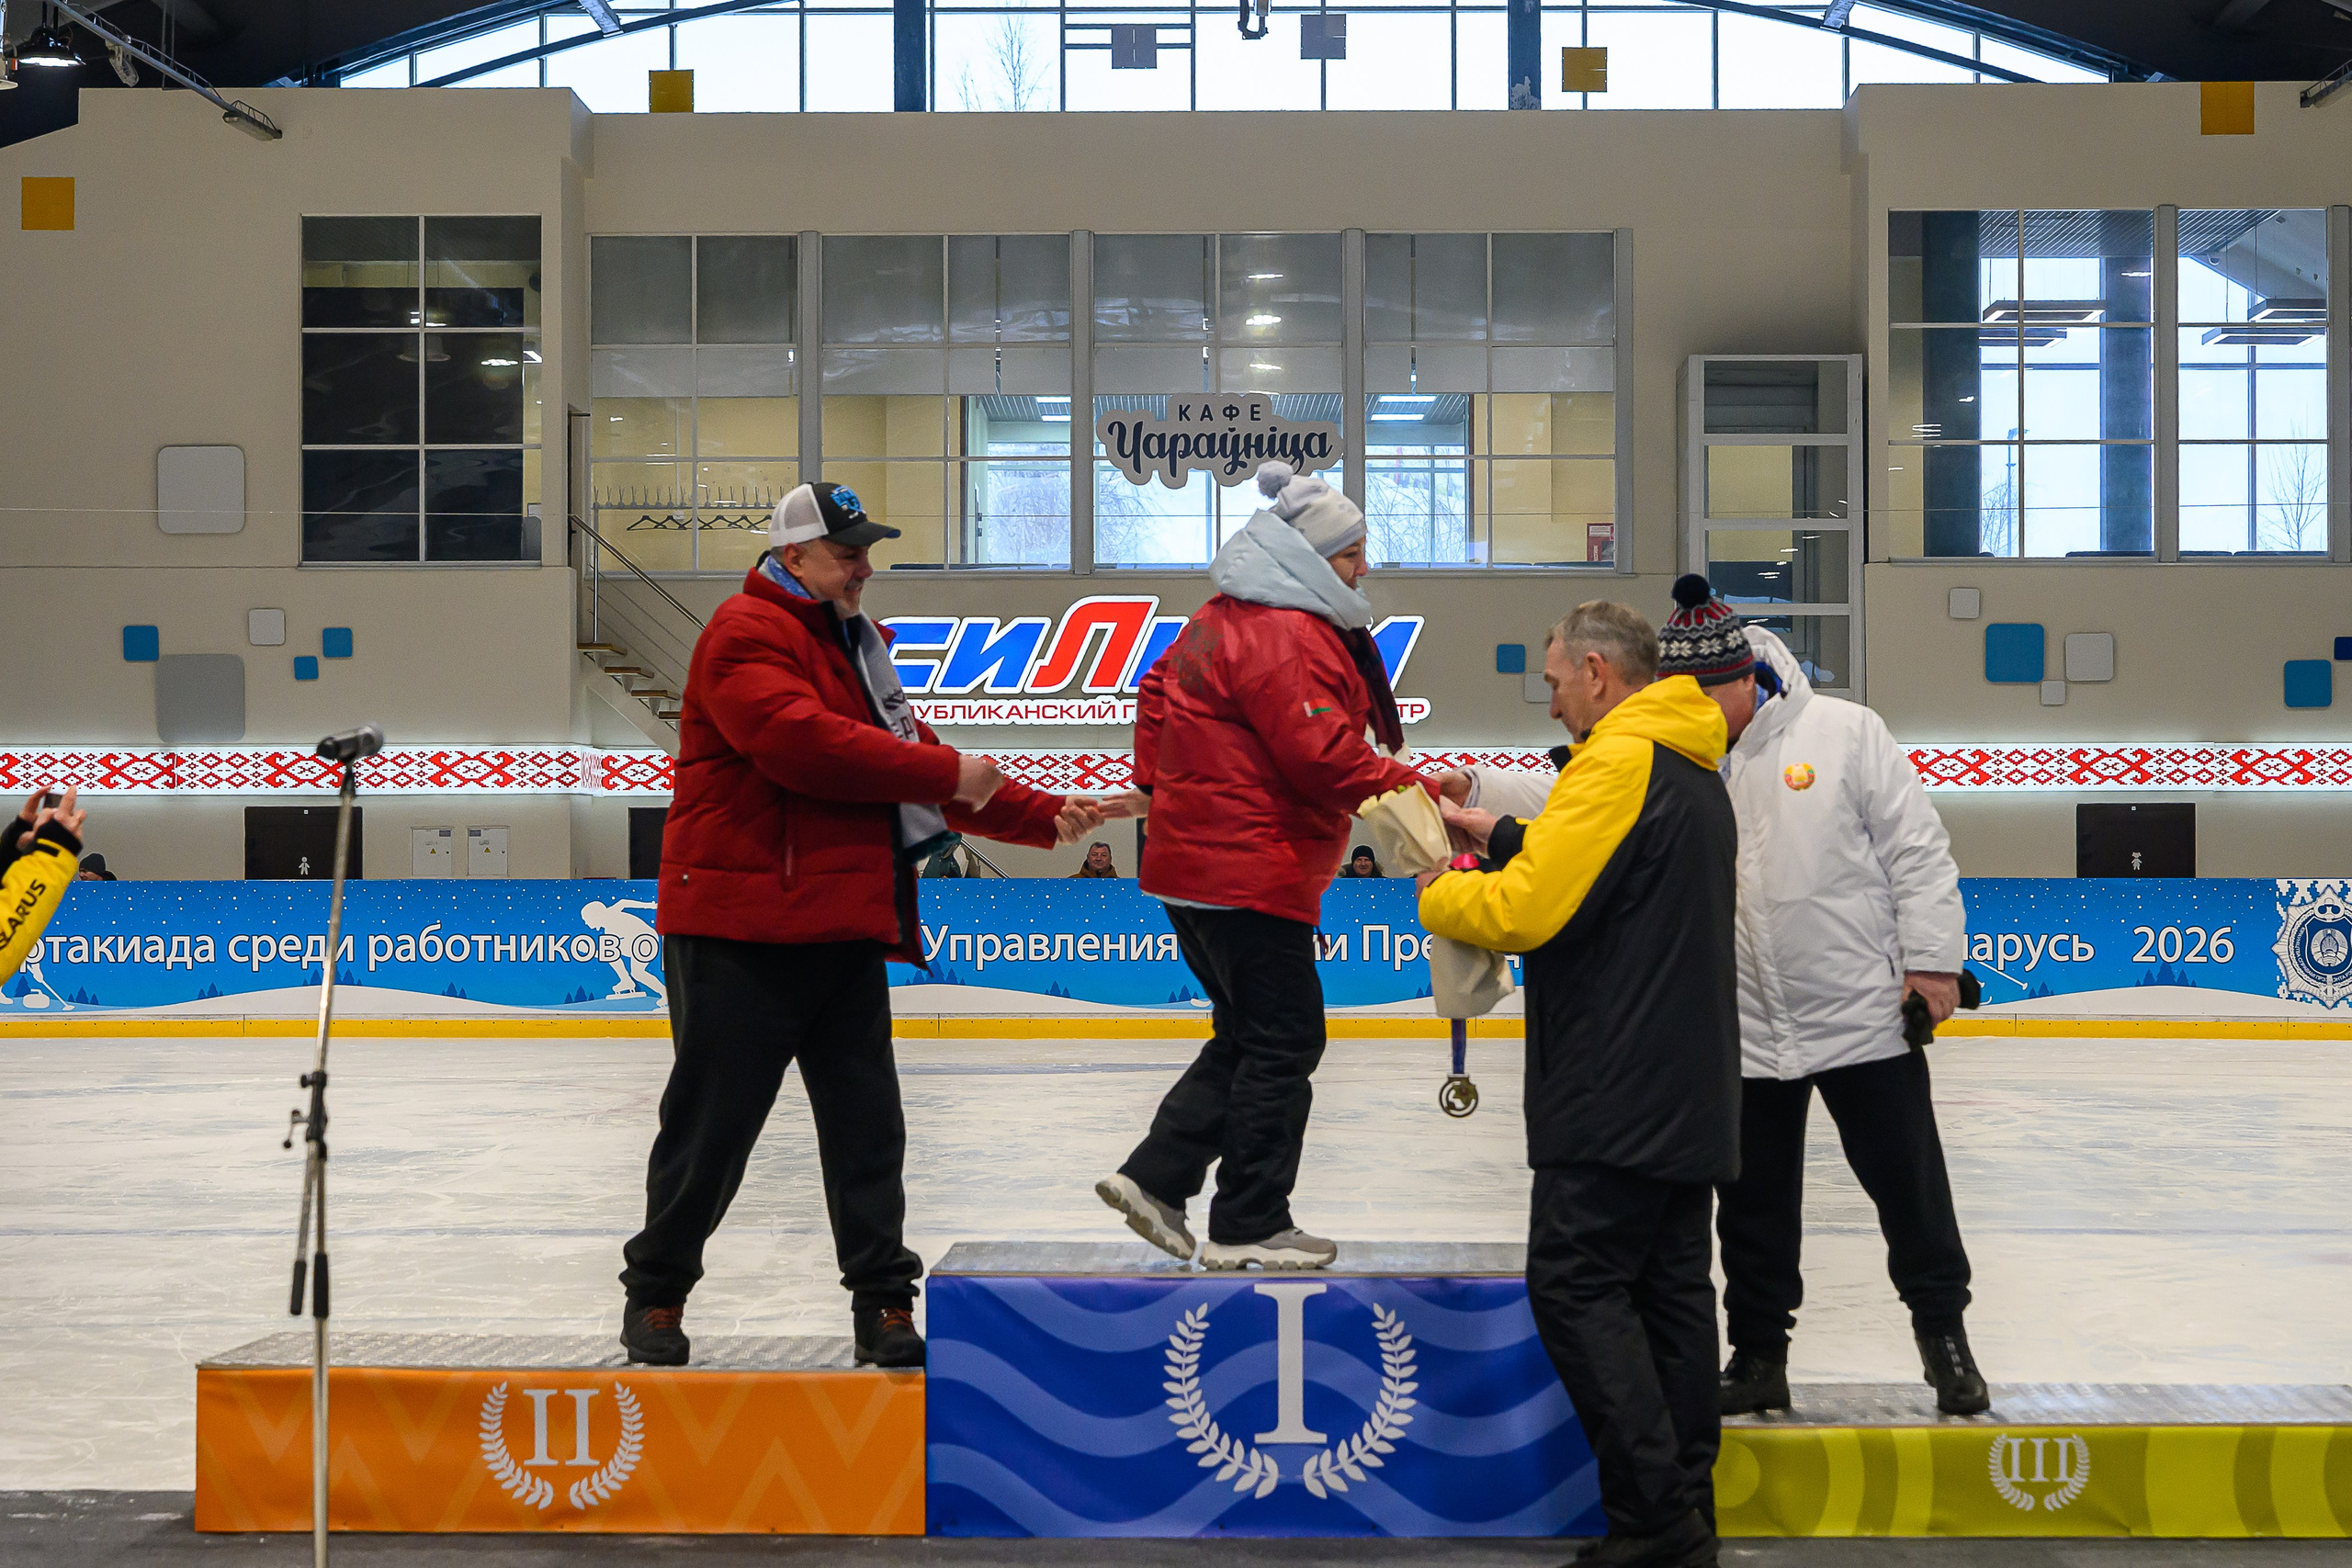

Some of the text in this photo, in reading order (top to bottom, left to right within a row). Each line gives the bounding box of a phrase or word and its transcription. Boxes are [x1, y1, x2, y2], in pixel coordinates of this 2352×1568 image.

[1178, 403, 1261, 422] КАФЕ
[1107, 420, 1333, 478] Чараўніца
[914, 701, 1116, 719] УБЛИКАНСКИЙ
[19, 934, 216, 974] ртакиада
[228, 934, 356, 972] среди
[368, 922, 622, 973] работников
[920, 924, 1180, 972] Управления
[1962, 933, 2096, 972] арусь
[2132, 925, 2236, 964] 2026
[1253, 1282, 1328, 1444] I
[523, 1388, 601, 1467] II
[2007, 1437, 2075, 1483] III
